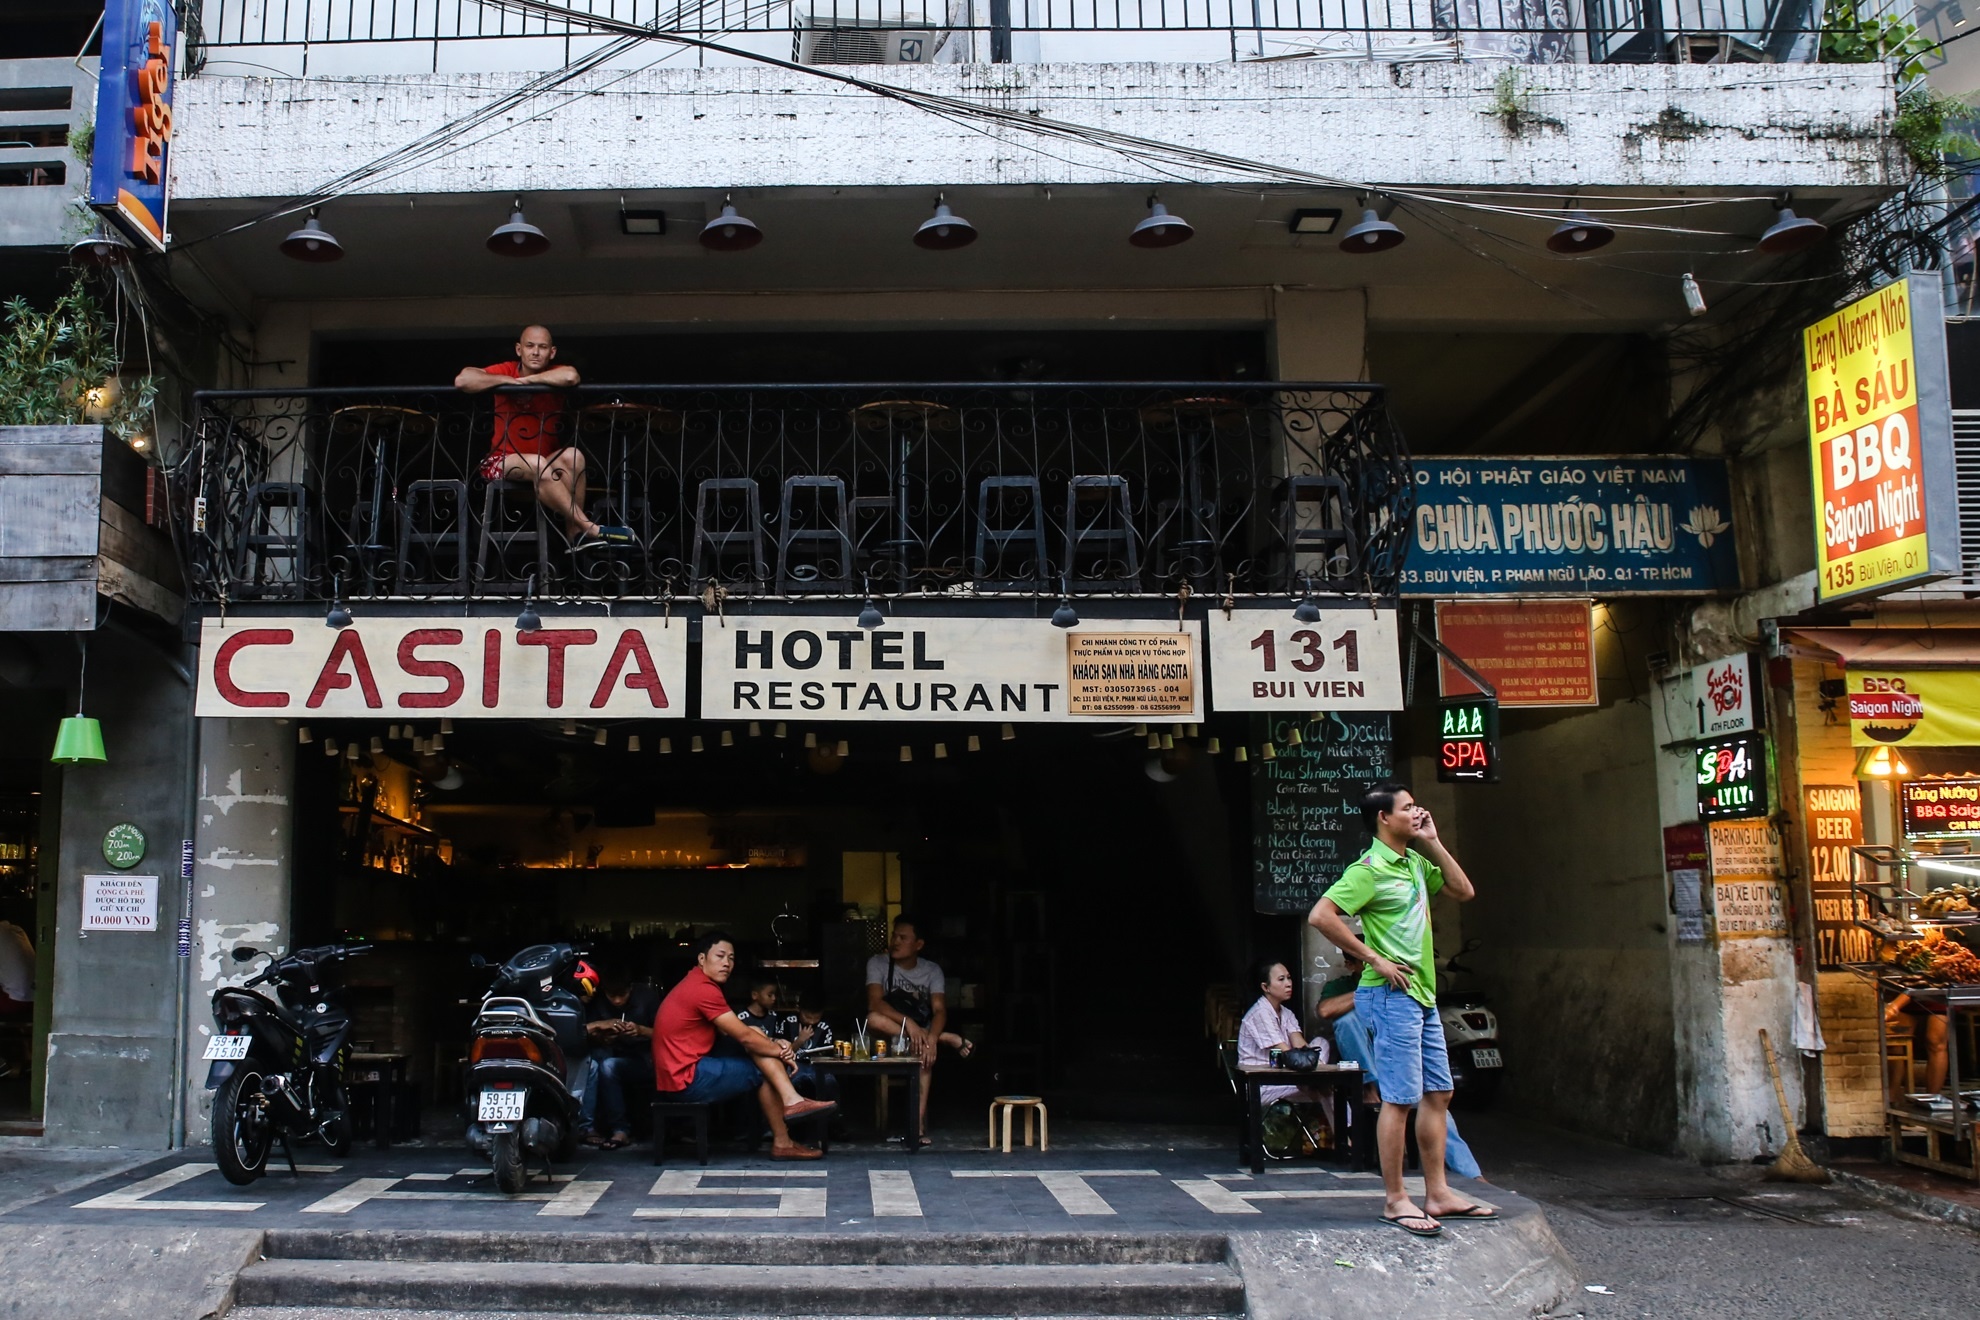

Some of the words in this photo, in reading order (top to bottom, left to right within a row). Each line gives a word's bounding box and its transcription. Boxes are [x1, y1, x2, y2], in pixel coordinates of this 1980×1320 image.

[131, 21, 173, 186] Tiger
[1808, 325, 1837, 376] Làng
[1837, 304, 1880, 360] Nướng
[1879, 281, 1907, 340] Nhỏ
[1814, 380, 1849, 434] BÀ
[1855, 358, 1910, 416] SÁU
[1831, 412, 1912, 491] BBQ
[1440, 466, 1472, 489] HỘI
[1481, 466, 1533, 487] PHẬT
[1539, 466, 1586, 485] GIÁO
[1592, 465, 1636, 487] VIỆT
[1642, 469, 1686, 485] NAM
[1825, 496, 1875, 553] Saigon
[1876, 473, 1921, 538] Night
[1416, 495, 1500, 553] CHÙA
[1503, 494, 1606, 553] PHƯỚC
[1610, 494, 1675, 557] HẬU
[1398, 570, 1423, 584] 33.
[1491, 570, 1502, 582] P.
[1548, 565, 1575, 581] NGŨ
[1826, 561, 1855, 591] 135
[1859, 562, 1876, 582] Bùi
[1904, 550, 1920, 570] Q1
[734, 630, 945, 671] HOTEL
[1119, 638, 1137, 646] CÔNG
[1250, 629, 1359, 673] 131
[214, 628, 670, 709] CASITA
[1072, 660, 1100, 680] KHÁCH
[1101, 663, 1118, 683] SẠN
[1119, 660, 1136, 680] NHÀ
[1138, 660, 1160, 680] HÀNG
[1160, 664, 1188, 680] CASITA
[1252, 681, 1295, 698] BUI
[1304, 681, 1365, 698] VIEN
[1534, 677, 1547, 686] LAO
[1566, 676, 1588, 685] POLICE
[1576, 687, 1589, 696] 131
[1707, 663, 1744, 700] Sushi
[1863, 677, 1907, 694] BBQ
[733, 682, 1060, 713] RESTAURANT
[1850, 700, 1889, 717] Saigon
[1891, 700, 1924, 717] Night
[1442, 707, 1483, 734] AAA
[1710, 721, 1722, 732] 4TH
[1723, 717, 1745, 731] FLOOR
[1443, 741, 1487, 768] SPA
[1701, 747, 1746, 784] SPA
[1810, 789, 1856, 812] SAIGON
[1915, 804, 1947, 818] BBQ
[108, 823, 127, 838] OPEN
[127, 824, 145, 845] HOUR
[1713, 827, 1751, 846] PARKING
[1816, 817, 1853, 840] BEER
[1948, 821, 1967, 831] CHI
[100, 879, 126, 887] KHÁCH
[1735, 886, 1749, 901] XE
[90, 915, 122, 925] 10.000
[125, 915, 151, 926] VND
[1815, 899, 1841, 921] TIGER
[1818, 928, 1868, 965] 17.000
[205, 1047, 246, 1058] 715.06
[213, 1036, 245, 1047] 59-M1
[486, 1093, 518, 1106] 59-F1
[480, 1106, 521, 1120] 235.79
